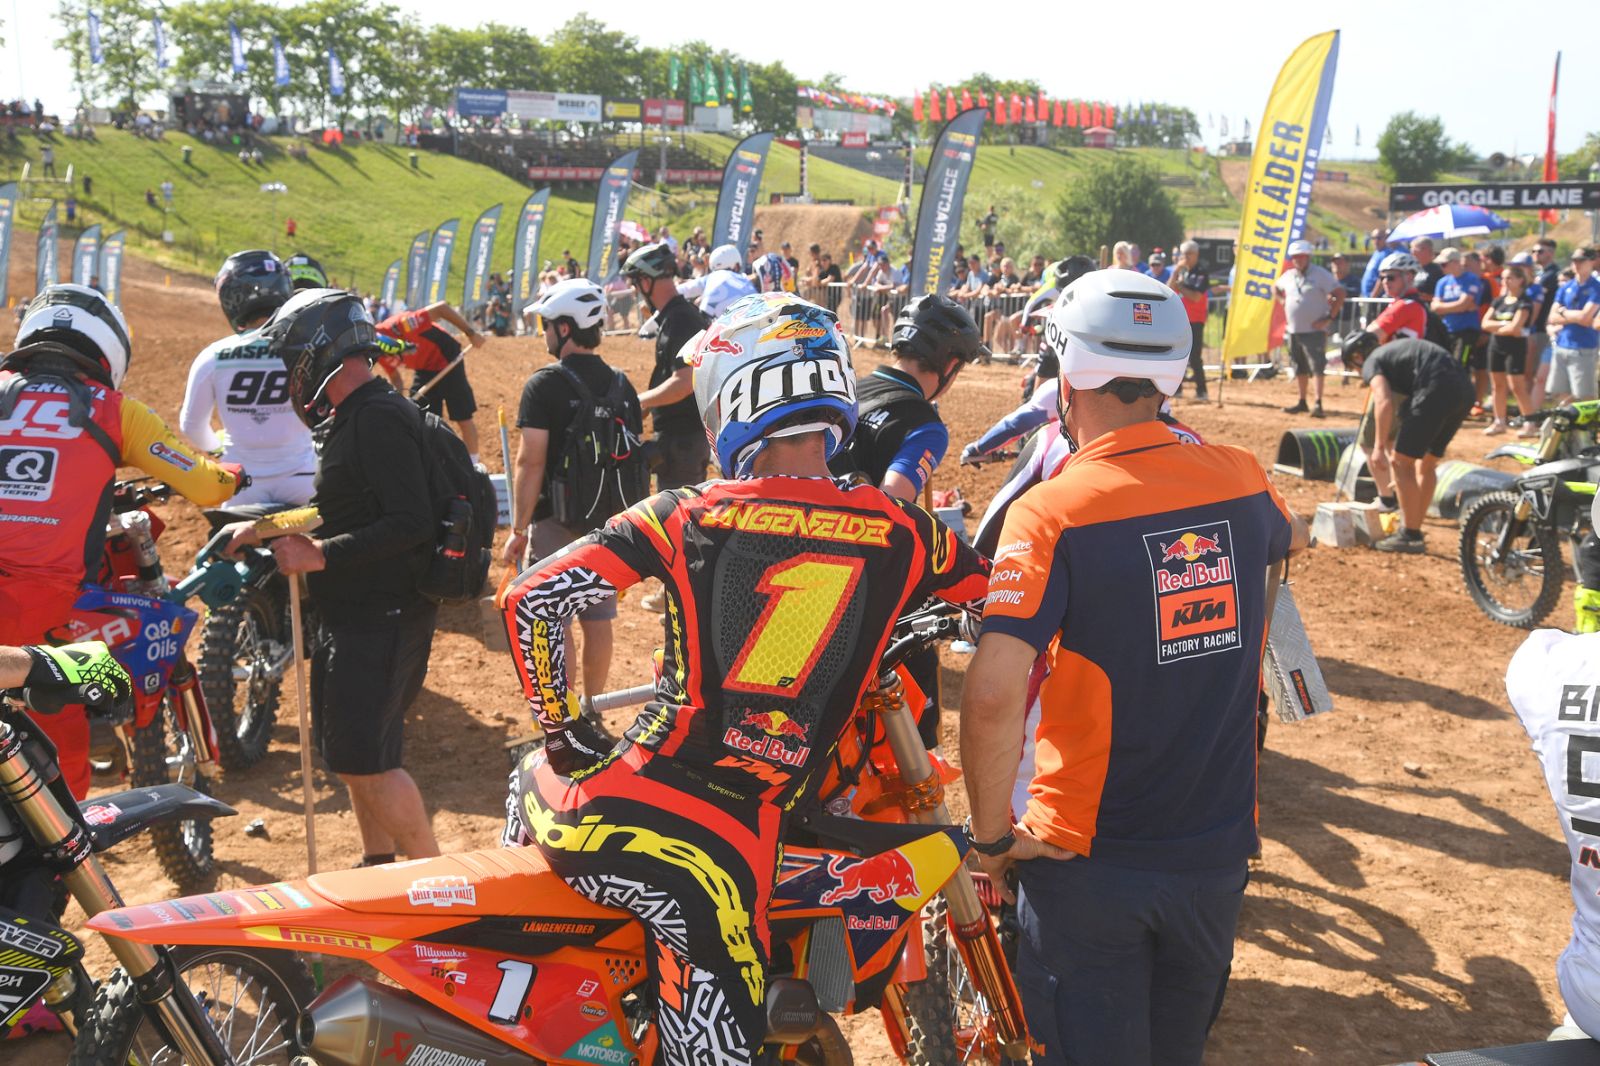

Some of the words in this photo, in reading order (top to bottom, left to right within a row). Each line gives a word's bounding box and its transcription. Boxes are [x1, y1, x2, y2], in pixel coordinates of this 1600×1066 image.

[1290, 148, 1319, 240] WORKWEAR
[1423, 189, 1515, 207] GOGGLE
[1521, 188, 1583, 205] LANE
[1243, 120, 1304, 301] BLÅKLÄDER
[226, 370, 291, 405] 98
[1157, 563, 1194, 593] Red
[1193, 556, 1232, 586] Bull
[722, 552, 866, 698] 1
[1171, 598, 1226, 629] KTM
[144, 620, 170, 640] Q8
[147, 639, 177, 661] Oils
[1162, 637, 1200, 657] FACTORY
[1203, 630, 1237, 649] RACING
[723, 727, 770, 756] Red
[765, 739, 811, 768] Bull
[707, 782, 746, 801] SUPERTECH
[522, 920, 596, 934] LÄNGENFELDER
[848, 915, 875, 930] Red
[874, 915, 899, 930] Bull
[279, 927, 372, 950] PIRELLI
[412, 944, 468, 958] Milwaukee
[488, 959, 538, 1025] 1
[577, 1043, 628, 1064] MOTOREX
